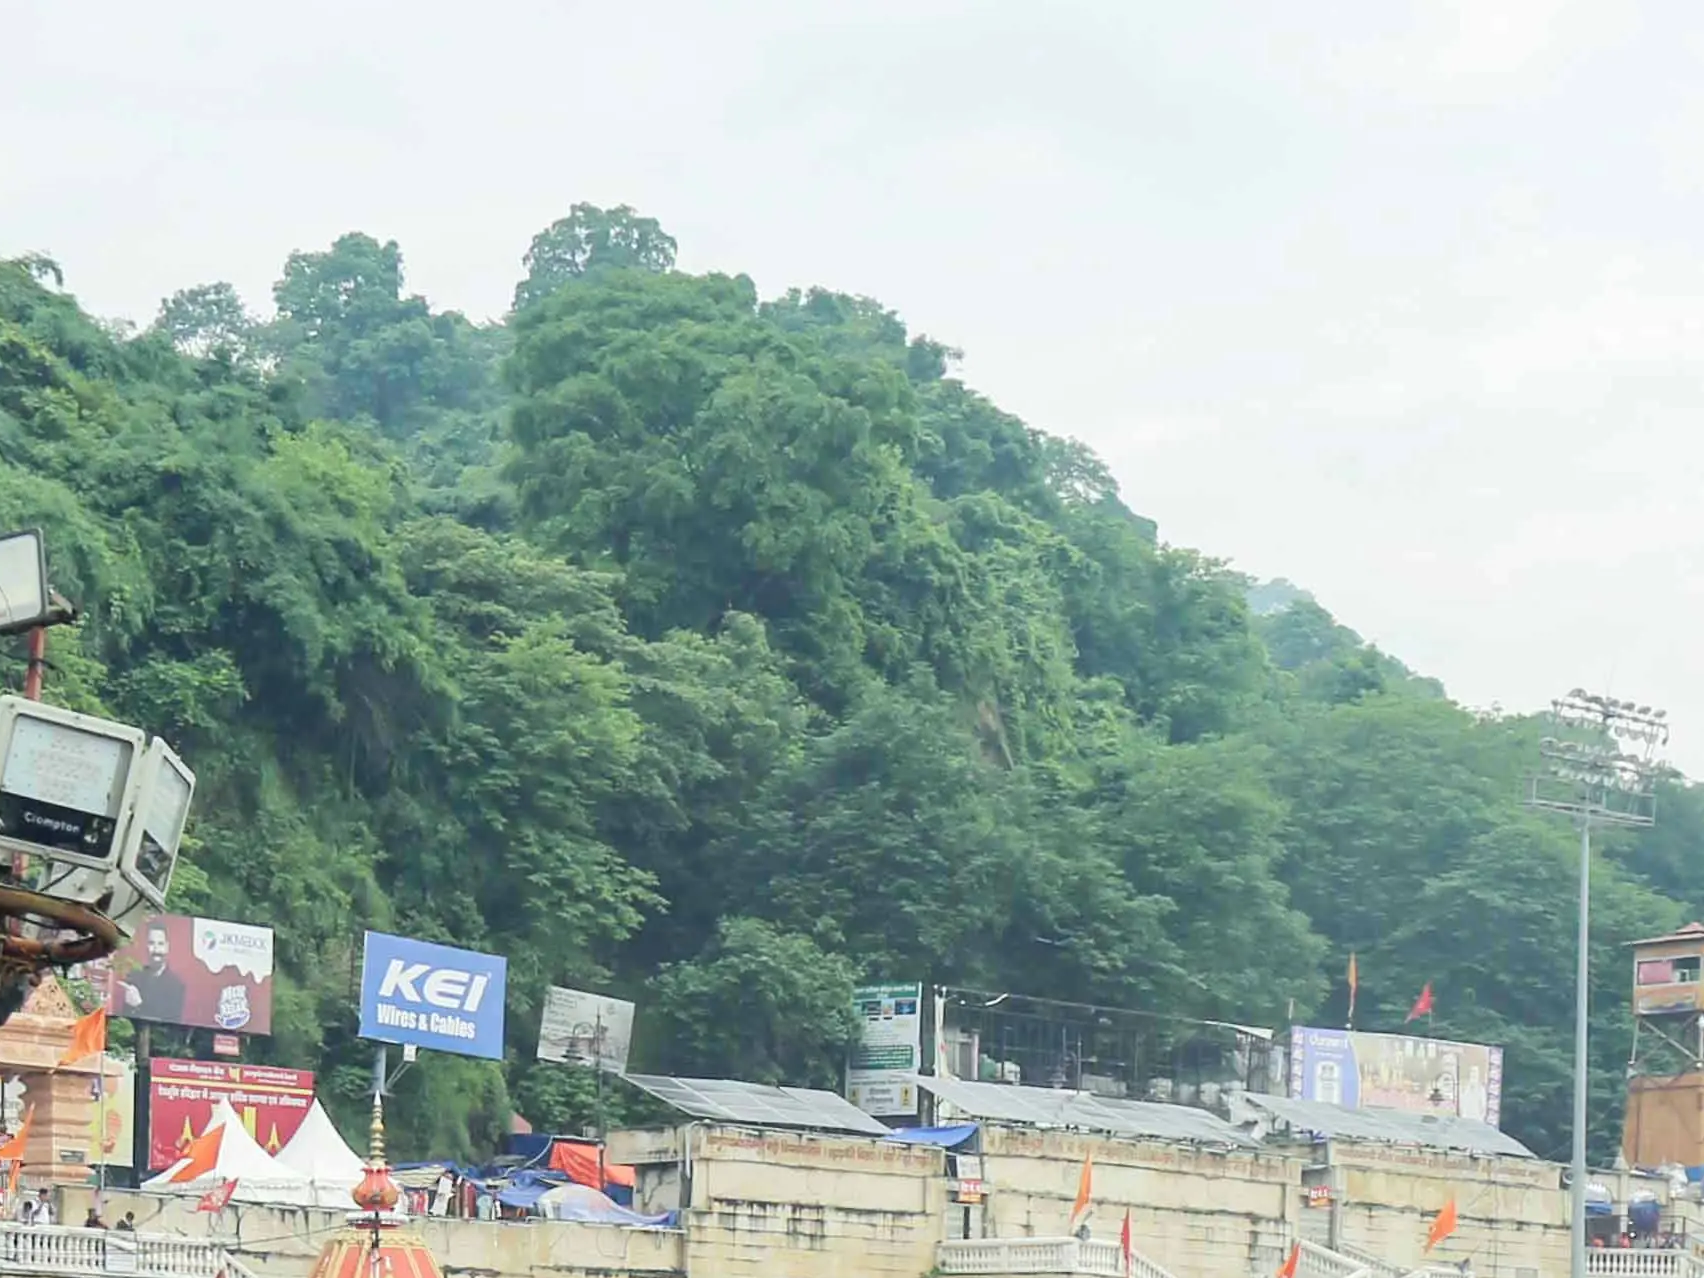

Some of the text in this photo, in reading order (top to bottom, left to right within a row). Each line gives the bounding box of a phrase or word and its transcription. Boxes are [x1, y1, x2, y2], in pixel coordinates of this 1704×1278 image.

[379, 958, 489, 1013] KEI
[377, 1003, 476, 1040] Wires & Cables
